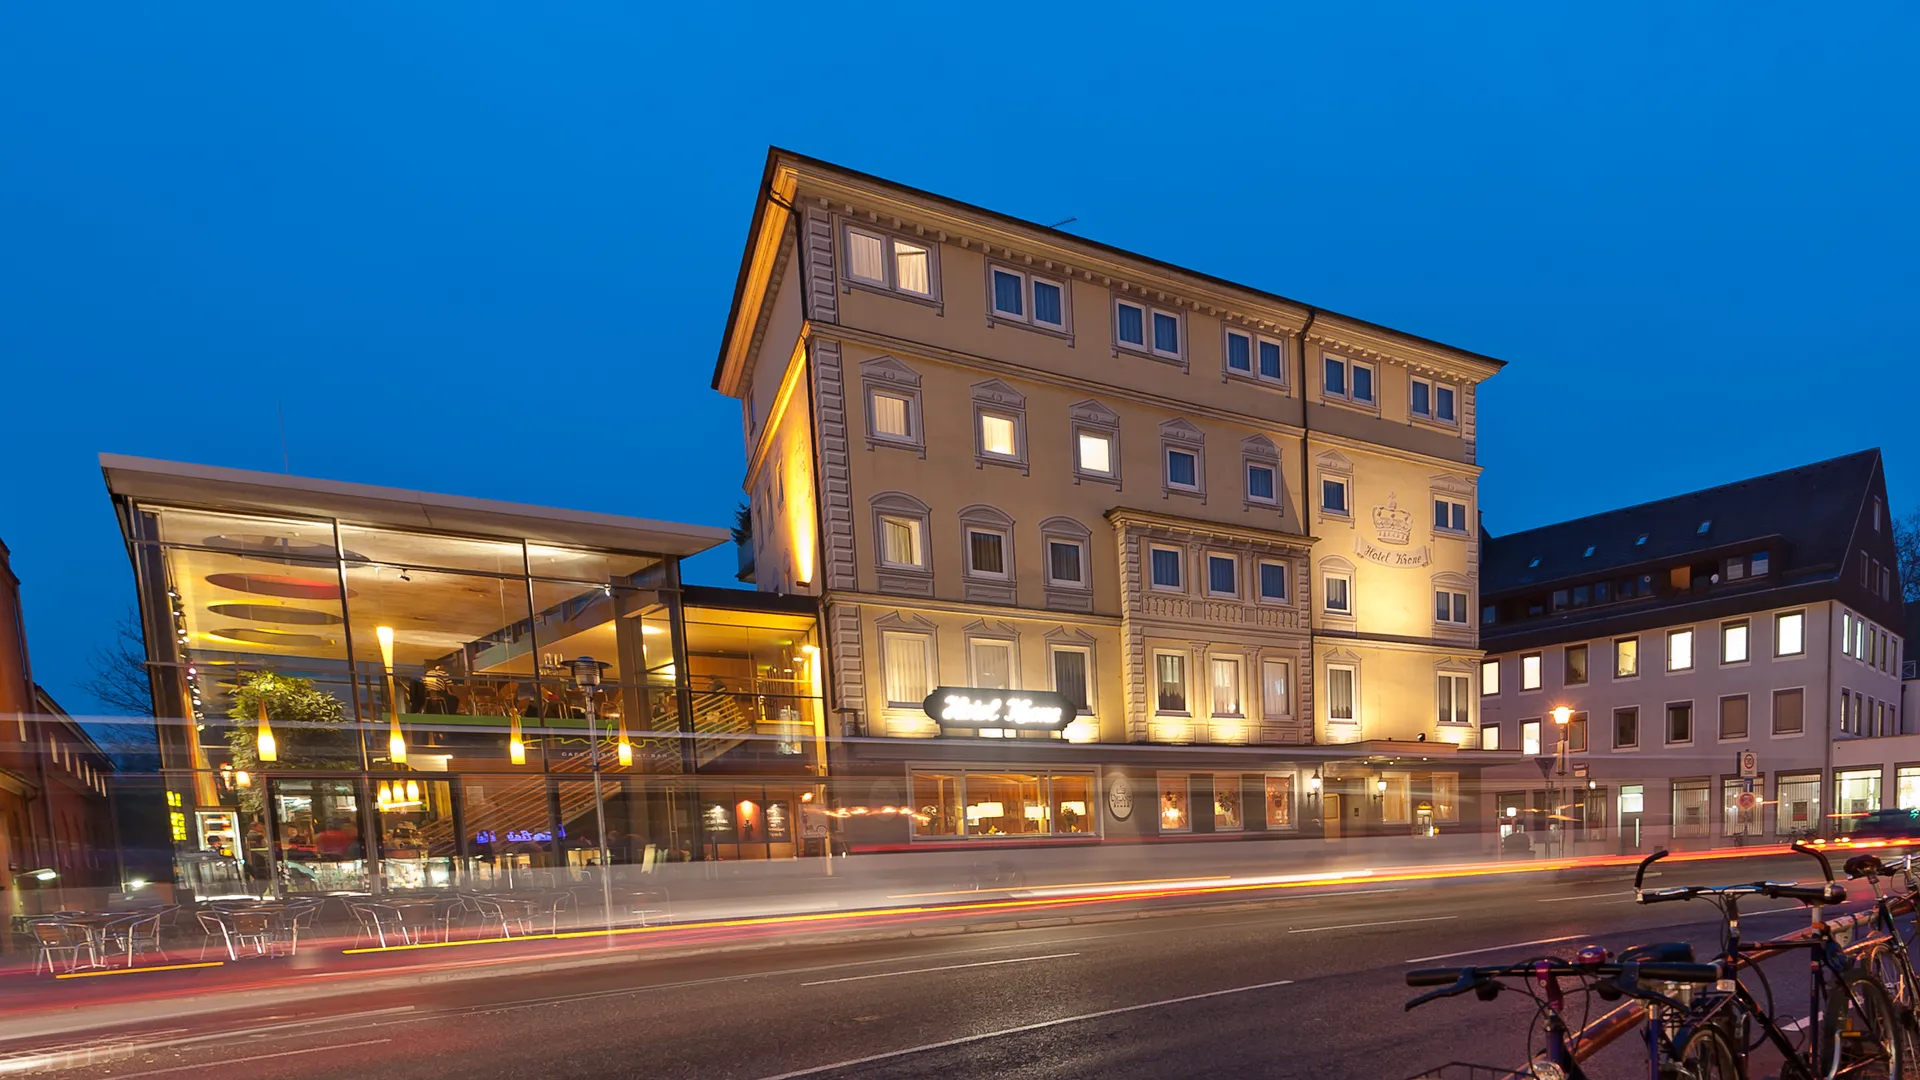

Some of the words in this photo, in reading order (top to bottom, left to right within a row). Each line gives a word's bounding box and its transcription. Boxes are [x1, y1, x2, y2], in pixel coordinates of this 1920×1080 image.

[1364, 545, 1391, 564] Hotel
[1395, 553, 1422, 565] Krone
[942, 695, 1002, 722] Hotel
[1003, 698, 1062, 724] Krone
